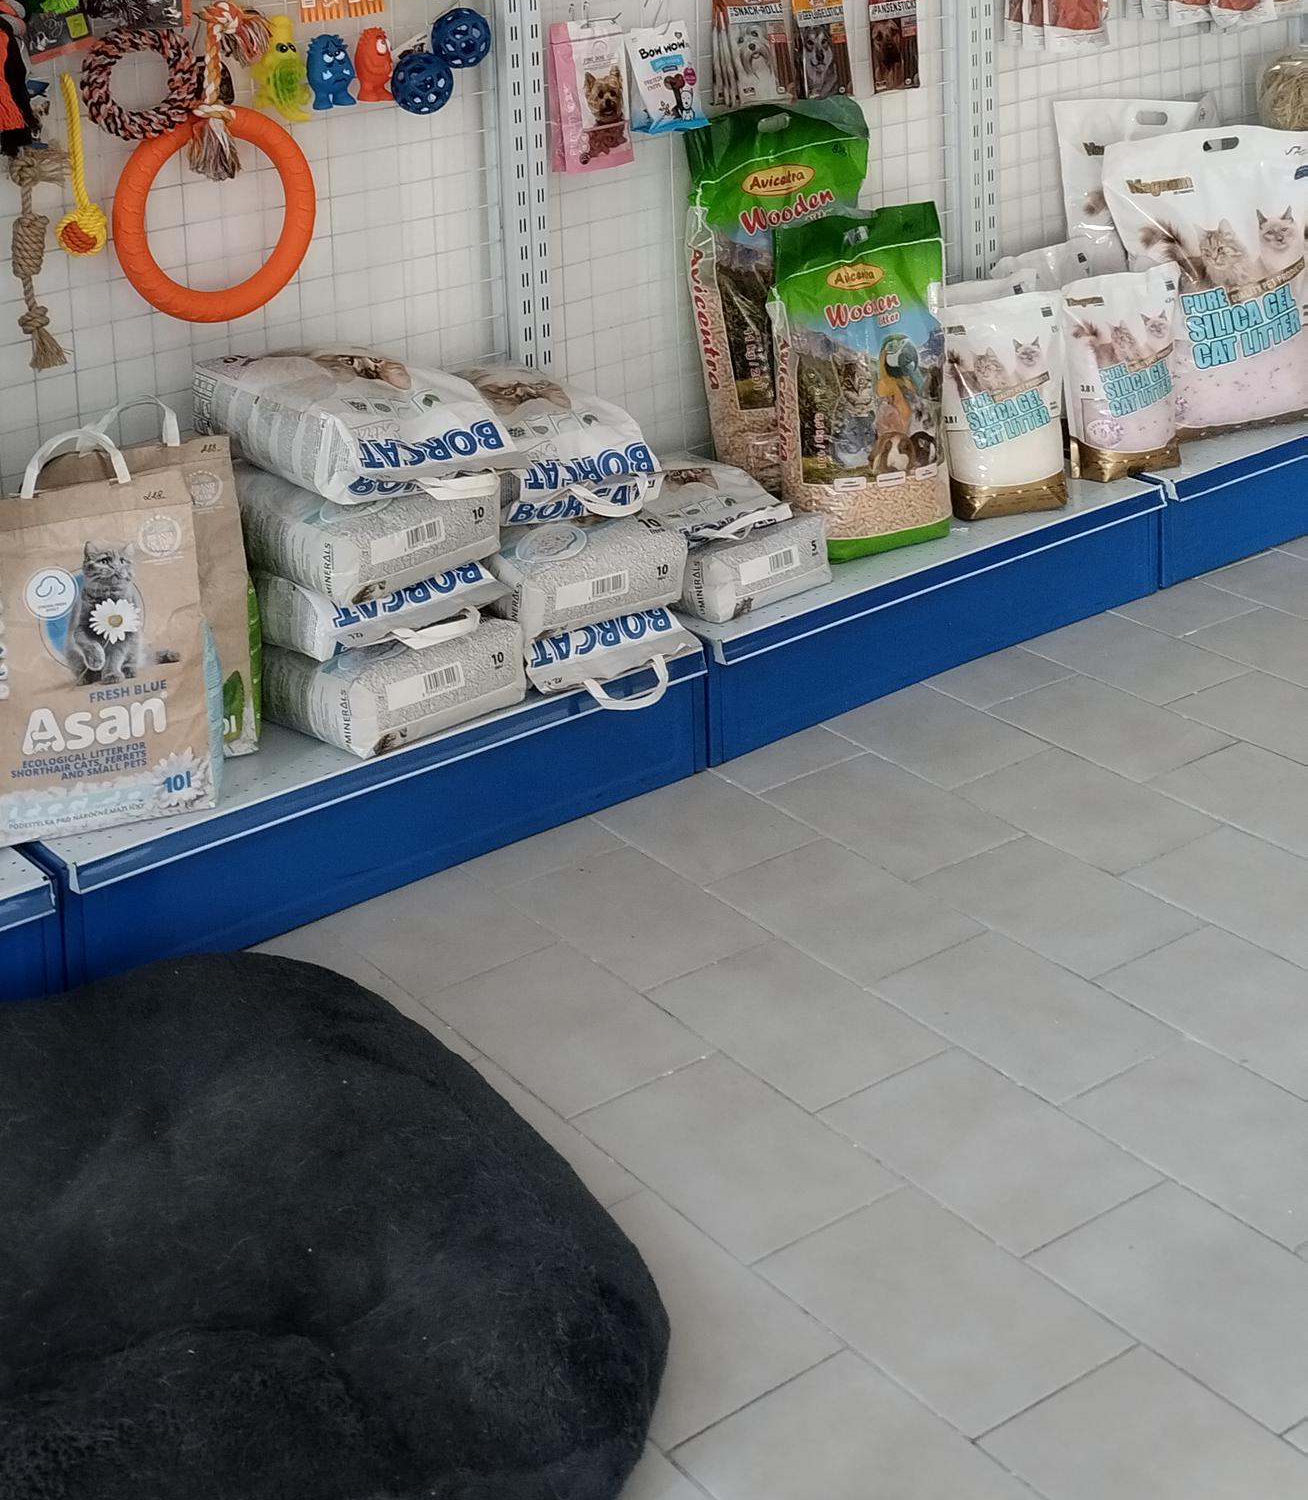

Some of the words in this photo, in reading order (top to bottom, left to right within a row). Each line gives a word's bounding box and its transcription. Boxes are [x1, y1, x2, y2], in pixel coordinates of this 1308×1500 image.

[740, 190, 835, 235] Wooden
[1182, 287, 1229, 315] PURE
[1187, 300, 1263, 342] SILICA
[1263, 283, 1296, 320] GEL
[690, 248, 721, 390] Avicentra
[1193, 336, 1237, 369] CAT
[1240, 308, 1301, 357] LITTER
[1100, 363, 1128, 382] PURE
[1103, 370, 1152, 400] SILICA
[1151, 361, 1169, 382] GEL
[777, 338, 793, 461] Avicentra
[1016, 388, 1044, 413] GEL
[1109, 394, 1139, 418] CAT
[1138, 376, 1173, 410] LITTER
[1003, 406, 1050, 439] LITTER
[358, 419, 505, 468] BORCAT
[524, 442, 655, 490] BORCAT
[472, 507, 485, 520] 10
[637, 518, 662, 529] 10
[811, 540, 817, 551] 5
[656, 564, 669, 577] 10
[530, 607, 673, 668] BORCAT
[491, 651, 504, 665] 10
[90, 686, 130, 703] FRESH
[134, 679, 168, 695] BLUE
[22, 698, 167, 755] Asan
[11, 763, 71, 779] SHORTHAIR
[105, 751, 147, 765] FERRETS
[22, 753, 87, 769] ECOLOGICAL
[90, 746, 123, 758] LITTER
[126, 742, 146, 753] FOR
[61, 770, 84, 780] AND
[87, 764, 121, 776] SMALL
[124, 758, 147, 770] PETS
